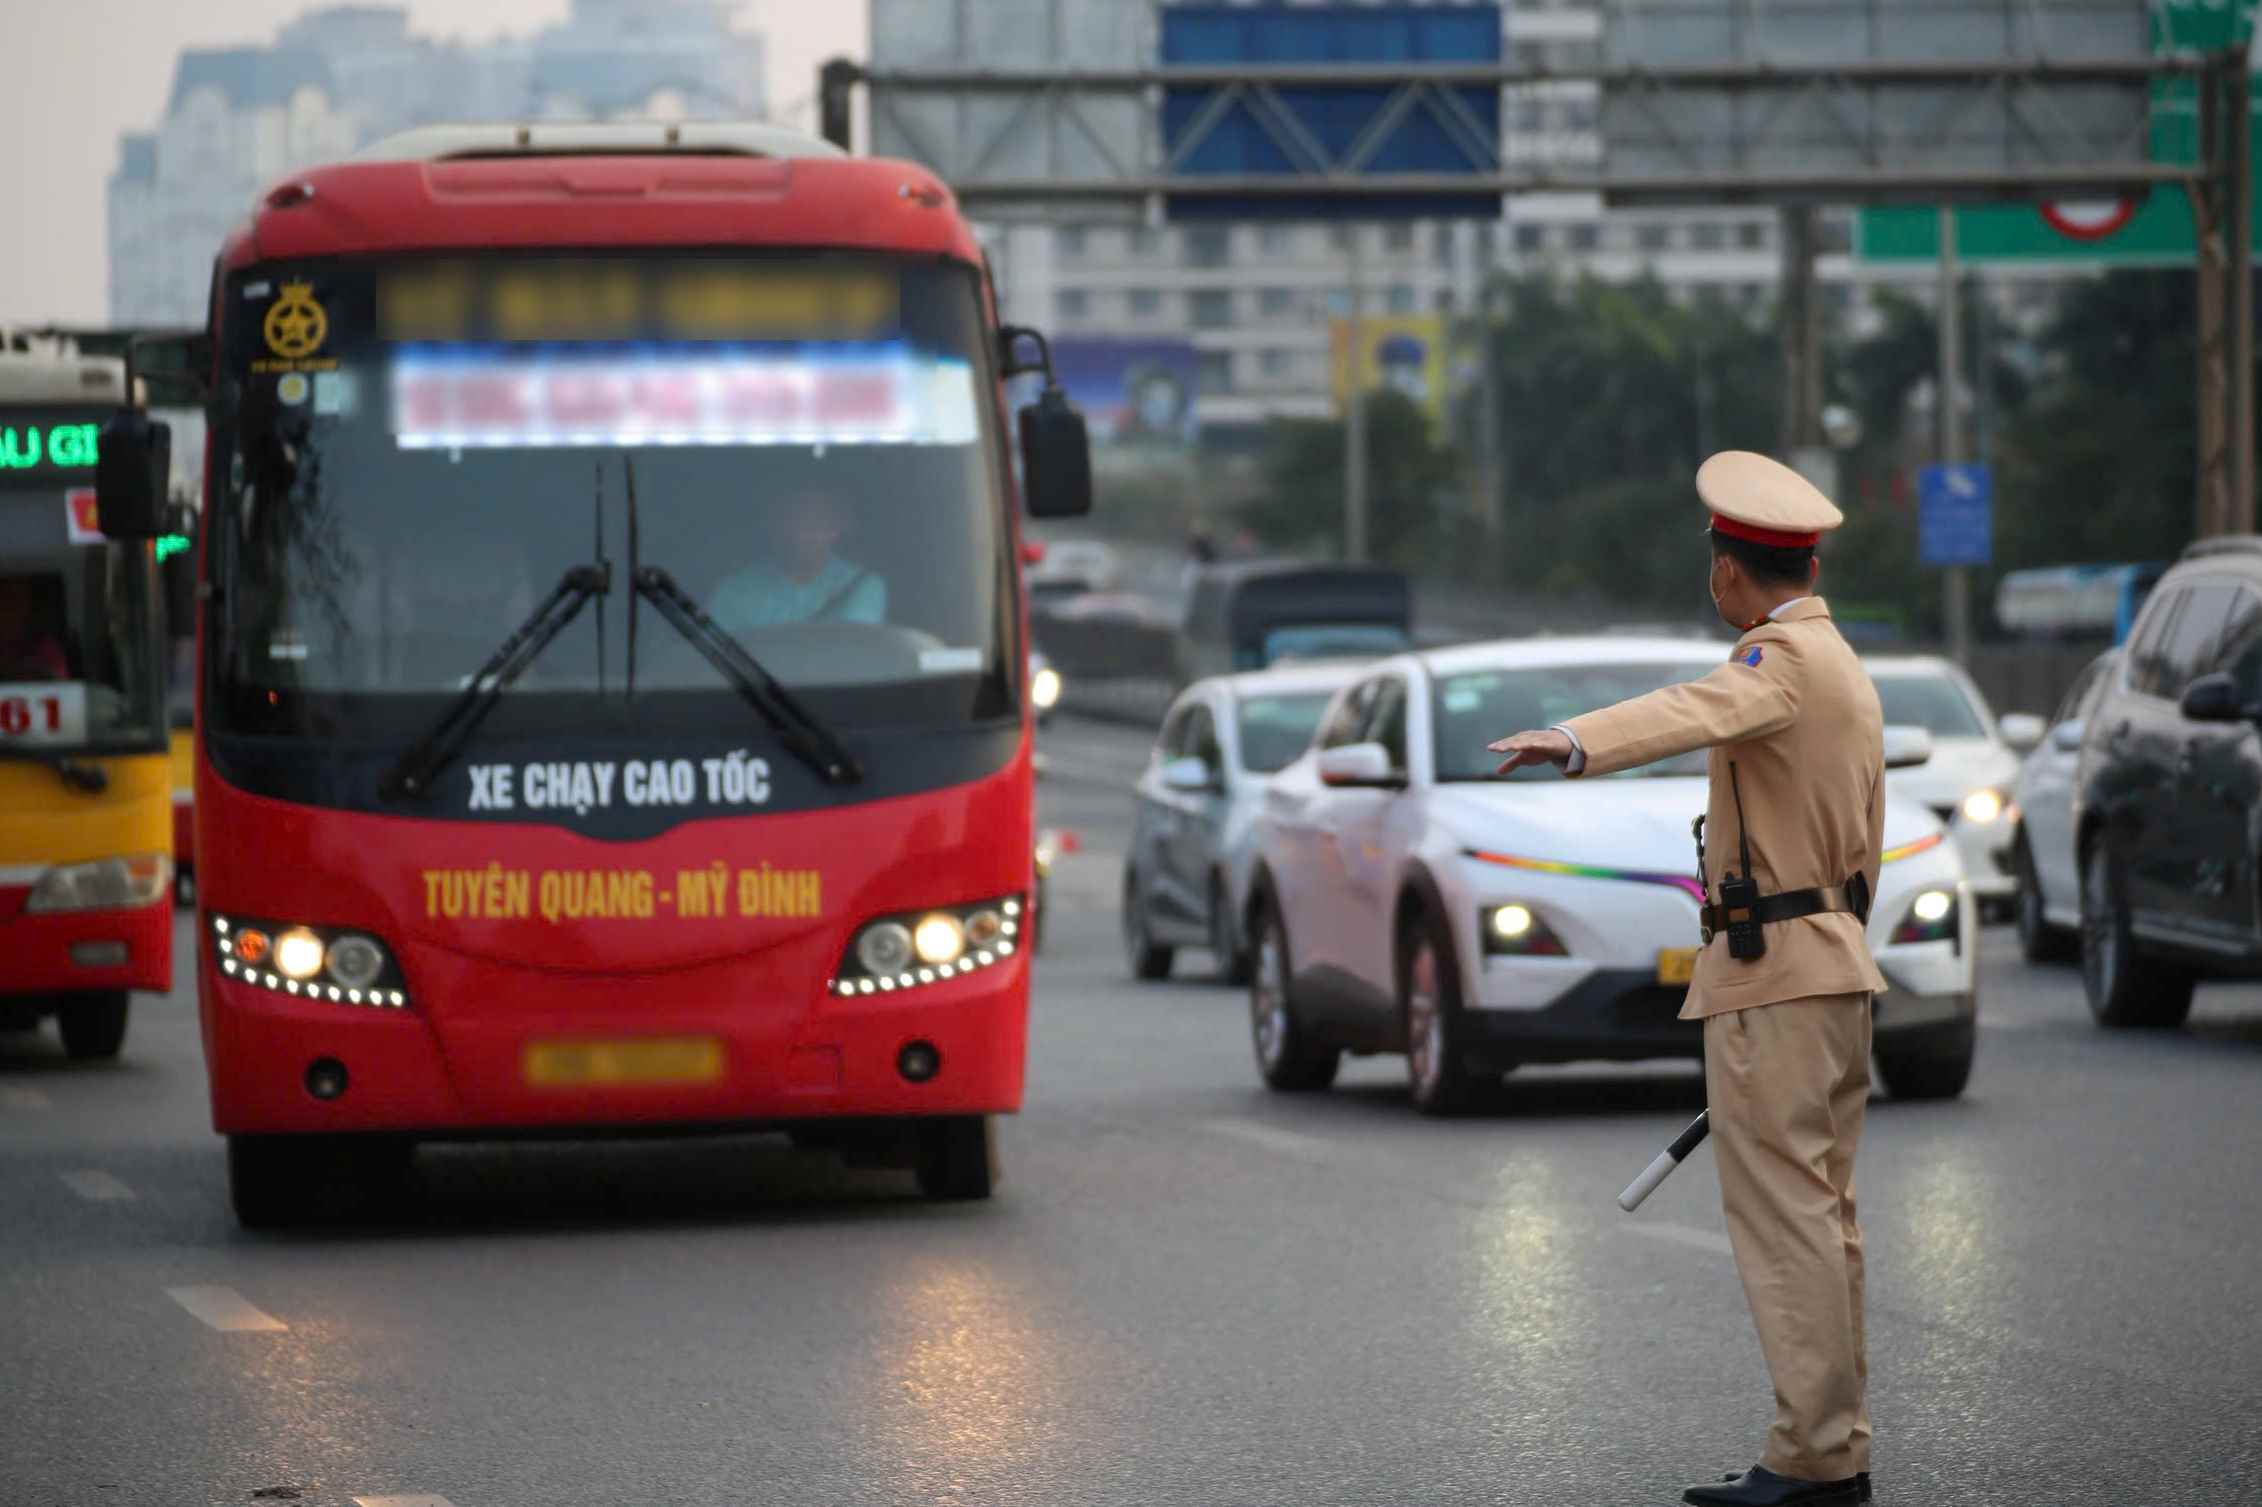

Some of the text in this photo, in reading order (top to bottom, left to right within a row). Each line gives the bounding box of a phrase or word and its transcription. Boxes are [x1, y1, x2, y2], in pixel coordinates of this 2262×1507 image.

[0, 426, 42, 468] U
[468, 748, 771, 816] XE CHẠY CAO TỐC
[423, 861, 530, 918] TUYÊN
[540, 869, 655, 922] QUANG
[677, 860, 729, 918] MỸ
[737, 860, 821, 918] ĐÌNH
